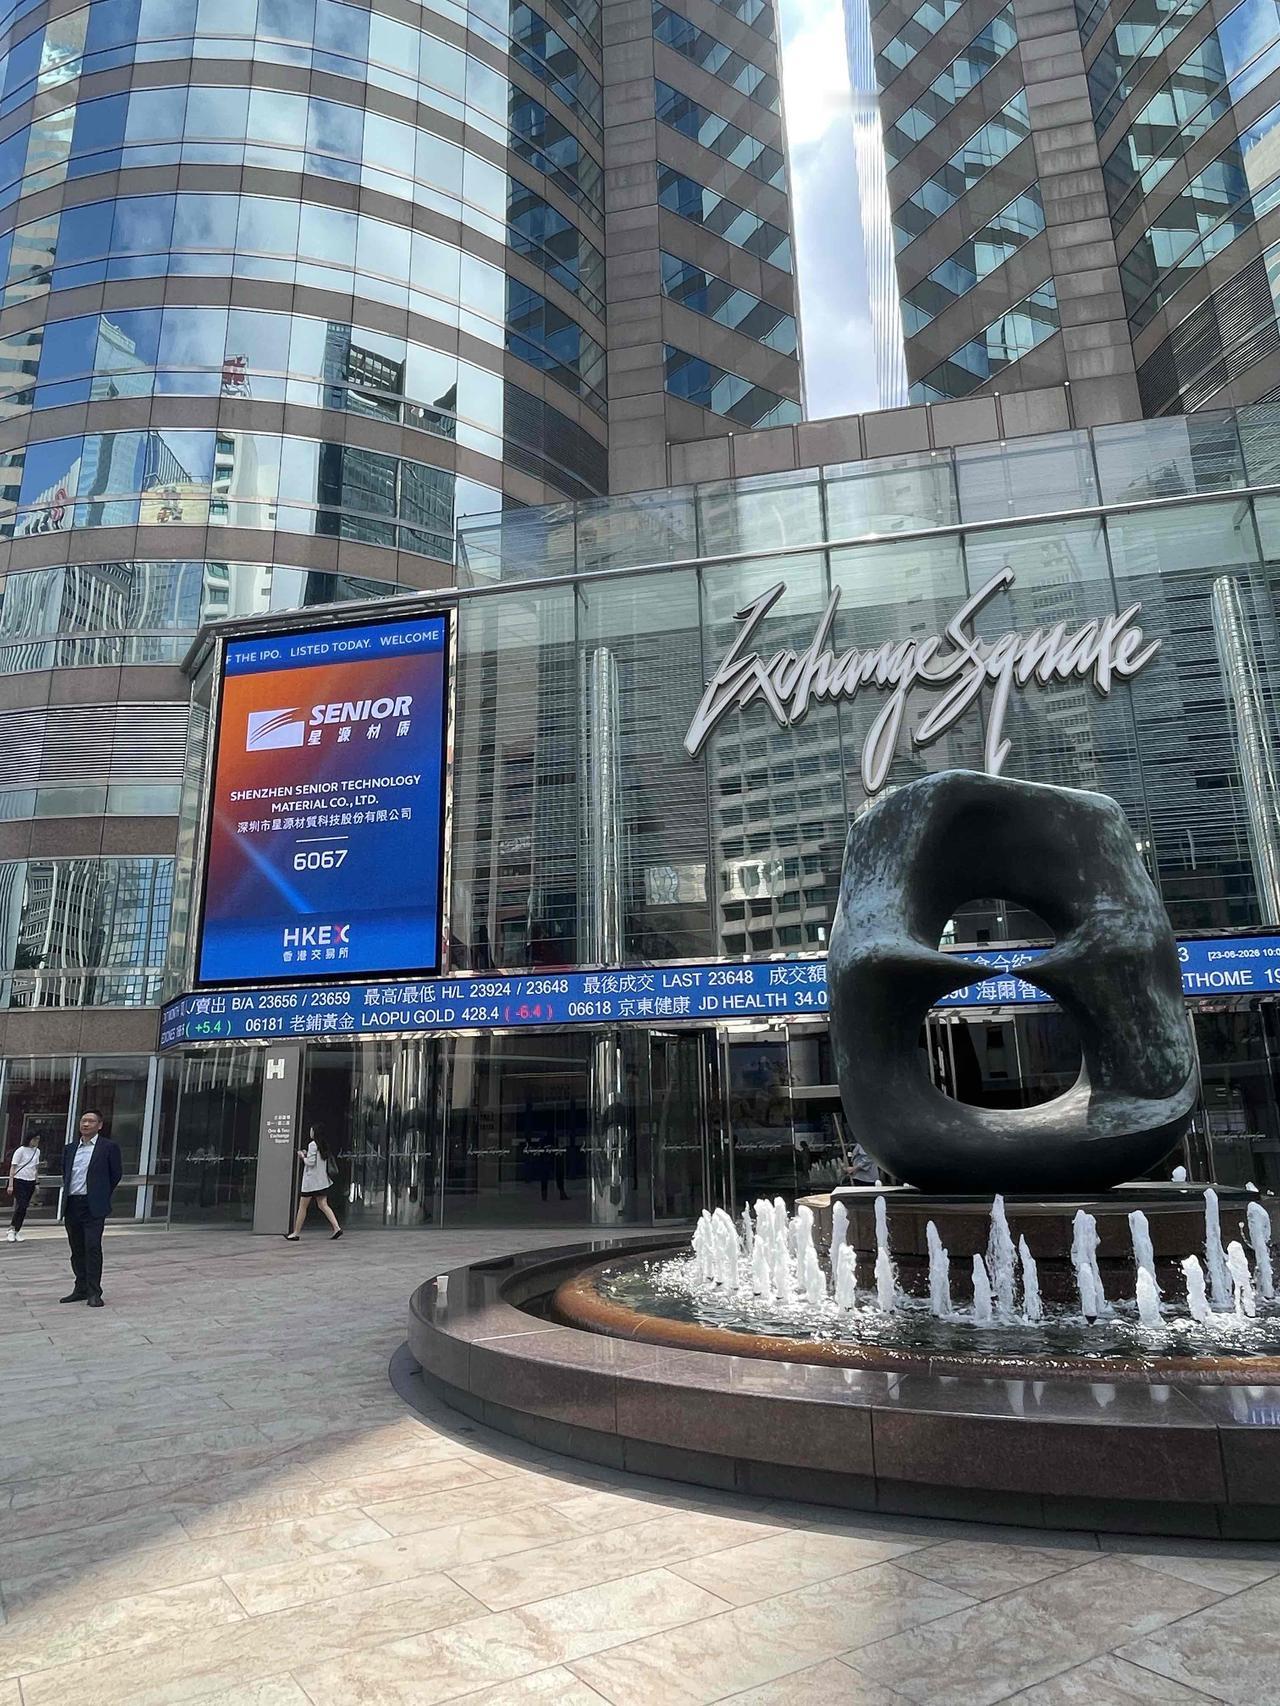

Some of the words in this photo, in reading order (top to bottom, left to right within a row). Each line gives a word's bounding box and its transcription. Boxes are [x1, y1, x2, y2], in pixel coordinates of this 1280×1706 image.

[235, 652, 257, 664] THE
[260, 650, 282, 661] IPO.
[290, 643, 329, 657] LISTED
[332, 638, 371, 652] TODAY.
[380, 630, 439, 646] WELCOME
[683, 581, 958, 795] Exchange
[914, 566, 1162, 775] Square
[309, 696, 412, 726] SENIOR
[230, 786, 292, 801] SHENZHEN
[295, 782, 338, 795] SENIOR
[341, 775, 421, 791] TECHNOLOGY
[271, 799, 327, 813] MATERIAL
[355, 794, 379, 805] LTD.
[237, 808, 412, 833] 深圳市星源材質科技股份有限公司
[293, 850, 348, 871] 6067
[283, 924, 350, 947] HKEX
[283, 947, 349, 962] 香港交易所
[232, 997, 254, 1010] B/A
[259, 994, 298, 1009] 23656
[311, 991, 350, 1006] 23659
[441, 985, 464, 999] H/L
[470, 982, 511, 998] 23924
[526, 980, 568, 994] 23648
[583, 973, 655, 995] 最後成交
[662, 973, 702, 988] LAST
[708, 970, 754, 986] 23648
[769, 965, 827, 985] 成交額
[976, 979, 1051, 1000] 海爾智
[1181, 970, 1253, 988] THOME
[245, 1017, 283, 1032] 06181
[361, 1011, 410, 1026] LAOPU
[414, 1008, 454, 1024] GOLD
[462, 1006, 499, 1021] 428.4
[568, 1001, 611, 1016] 06618
[617, 996, 691, 1017] 京東健康
[699, 996, 718, 1010] JD
[723, 993, 787, 1009] HEALTH
[795, 991, 827, 1006] 34.0
